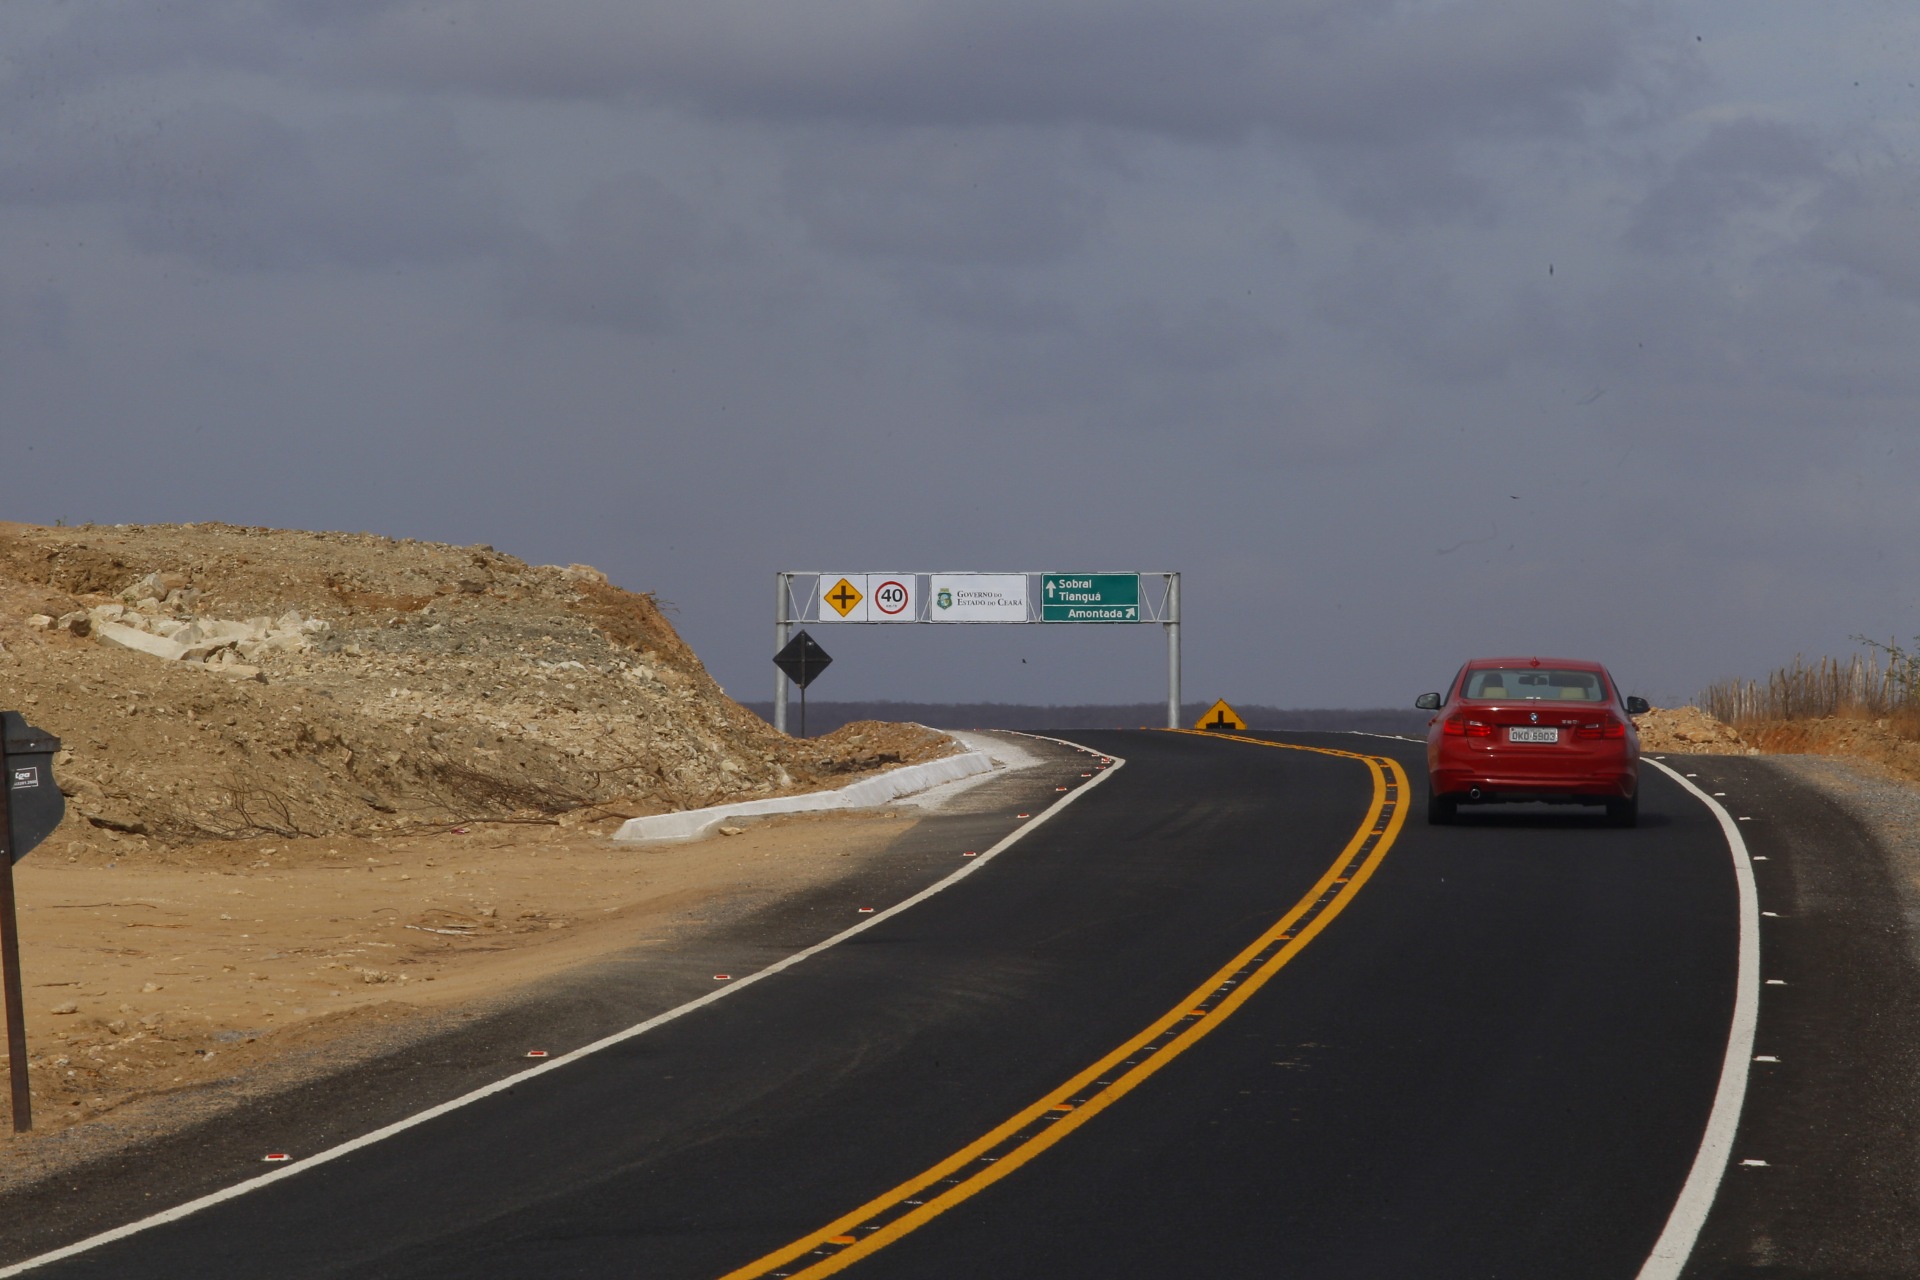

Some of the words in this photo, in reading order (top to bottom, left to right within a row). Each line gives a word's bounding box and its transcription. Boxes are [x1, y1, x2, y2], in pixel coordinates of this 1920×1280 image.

[1058, 579, 1092, 589] Sobral
[880, 588, 903, 603] 40
[1058, 591, 1101, 604] Tianguá
[1068, 608, 1123, 618] Amontada
